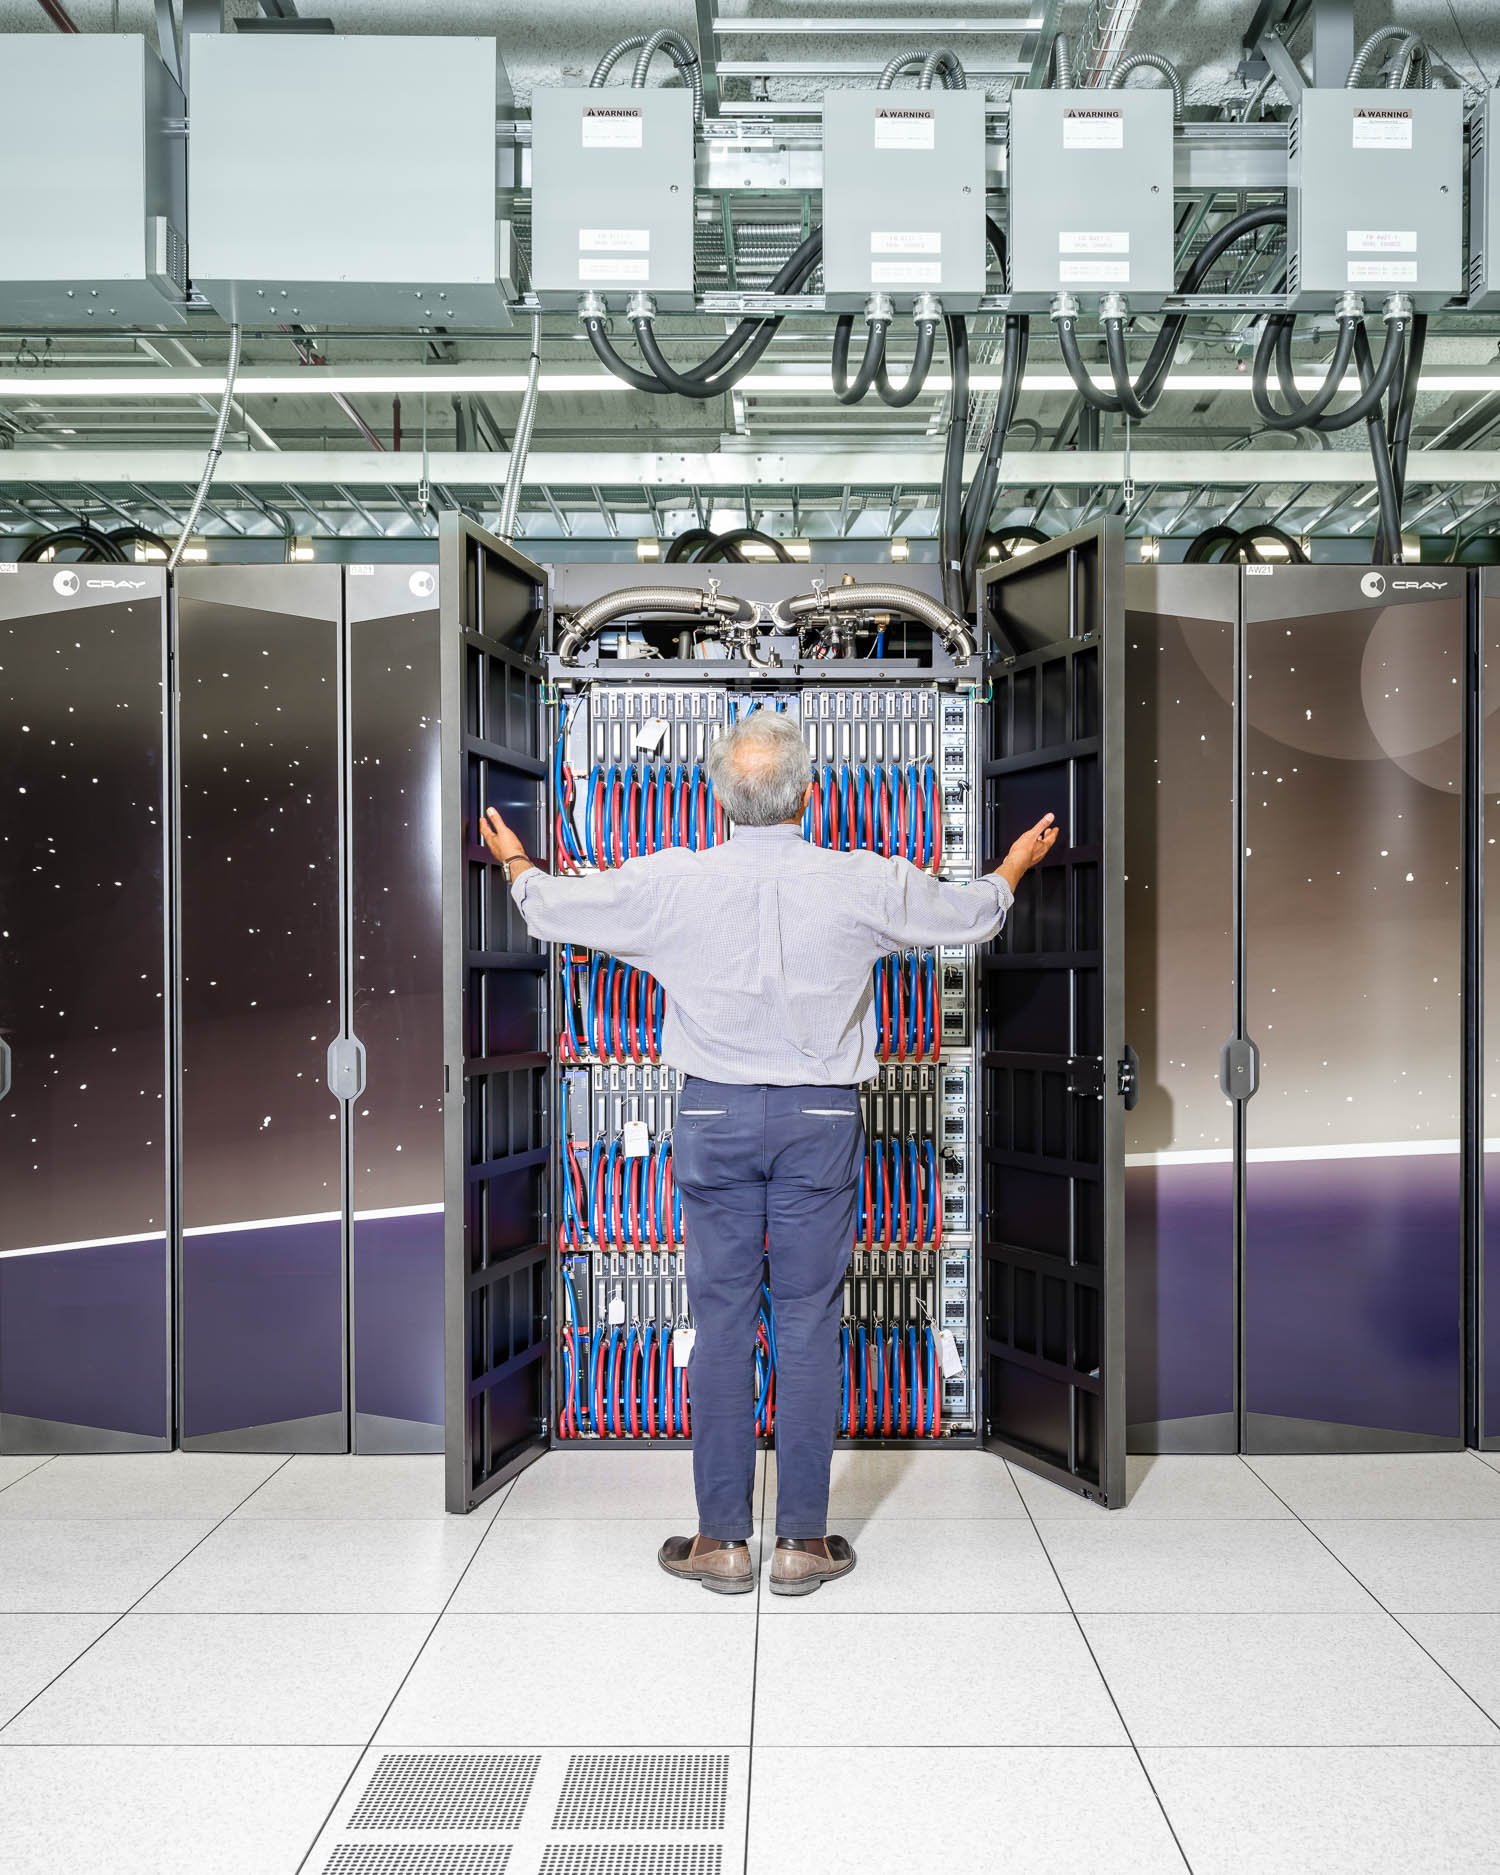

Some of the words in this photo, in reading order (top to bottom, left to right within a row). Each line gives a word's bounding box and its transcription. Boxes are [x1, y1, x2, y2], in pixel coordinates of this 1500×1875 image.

[639, 320, 647, 331] 1
[875, 323, 882, 334] 2
[926, 323, 933, 335] 3
[1112, 320, 1120, 331] 1
[1347, 319, 1355, 330] 2
[1396, 321, 1404, 332] 3
[1248, 566, 1271, 574] AW21
[86, 579, 146, 589] CRAY
[1392, 581, 1448, 590] CRAY
